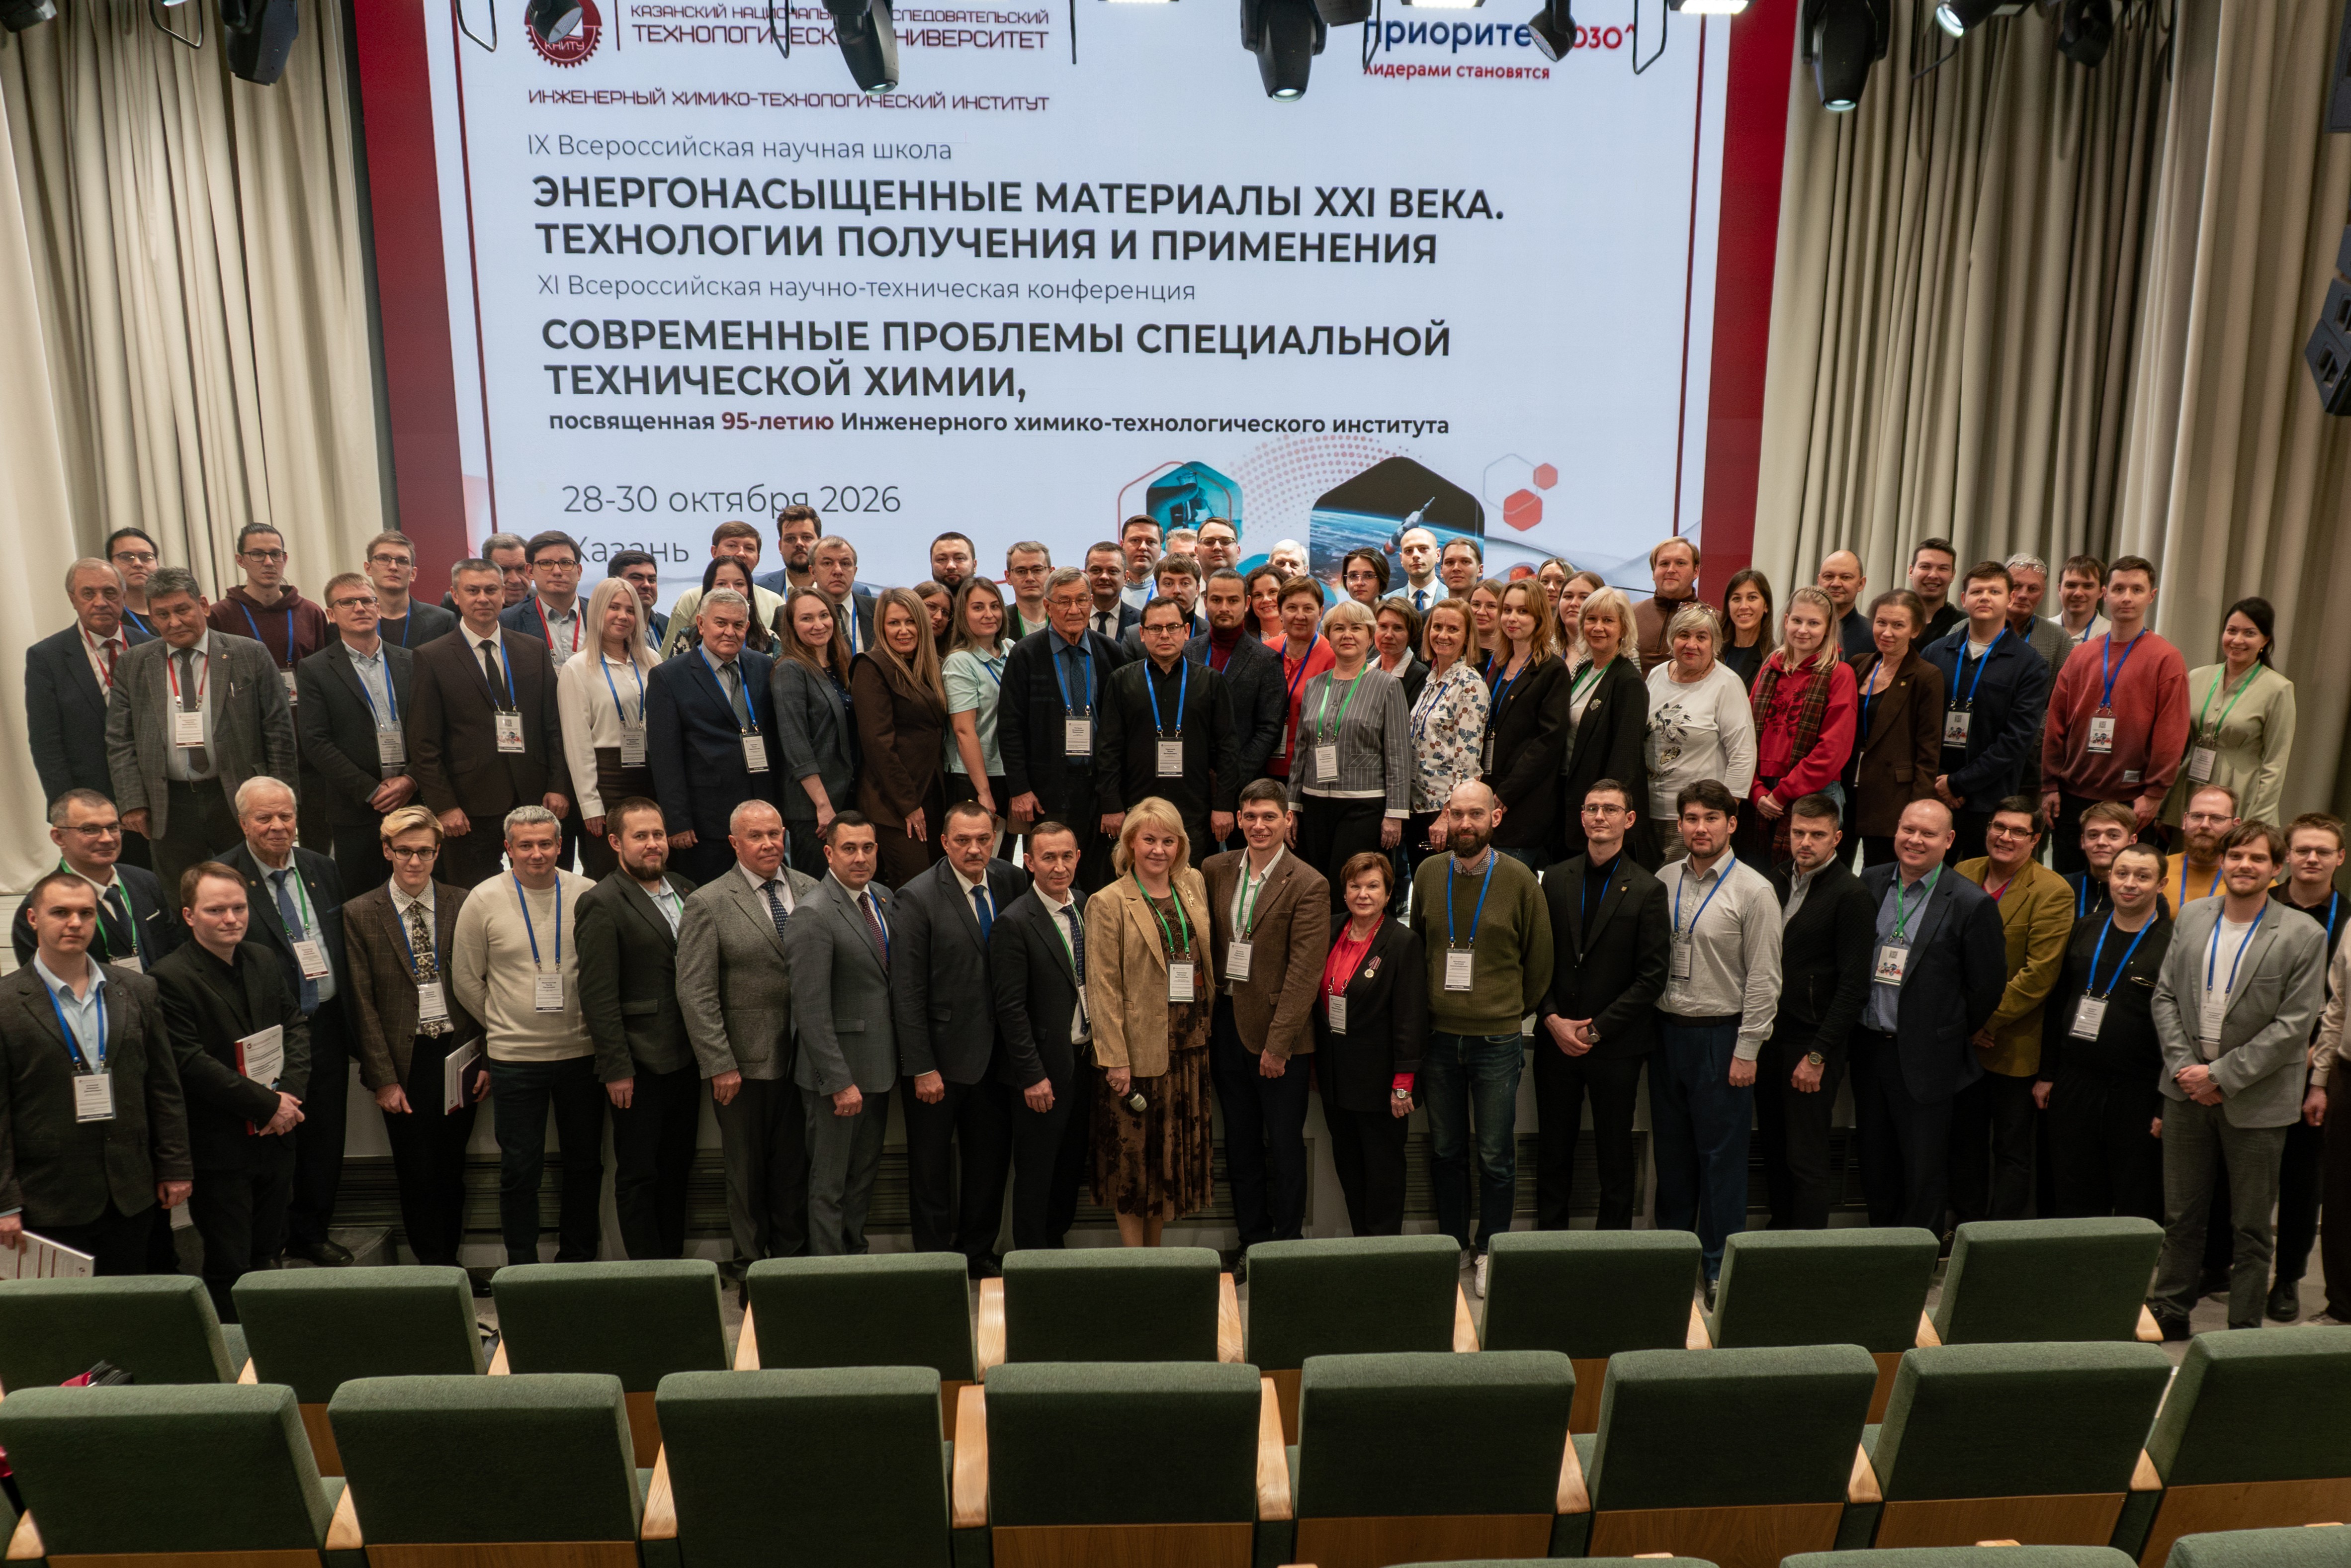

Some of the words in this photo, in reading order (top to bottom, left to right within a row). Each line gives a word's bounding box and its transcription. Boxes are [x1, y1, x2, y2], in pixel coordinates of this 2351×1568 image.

[631, 3, 727, 19] КАЗАНСКИЙ
[892, 9, 1049, 24] СЛЕДОВАТЕЛЬСКИЙ
[894, 28, 1049, 49] НИВЕРСИТЕТ
[1456, 65, 1550, 80] становятся
[528, 87, 666, 105] ИНЖЕНЕРНЫЙ
[672, 91, 946, 109] ХИМИКО-ТЕХНОЛОГИЧЕСКИЙ
[952, 95, 1050, 111] ИНСТИТУТ
[528, 134, 551, 155] IX
[558, 134, 754, 161] Всероссийская
[763, 142, 864, 163] научная
[873, 143, 952, 160] школа
[532, 174, 1023, 216] ЭНЕРГОНАСЫЩЕННЫЕ
[1036, 182, 1302, 216] МАТЕРИАЛЫ
[1313, 186, 1375, 218] XXI
[1390, 188, 1504, 220] ВЕКА.
[534, 223, 823, 257] ТЕХНОЛОГИИ
[838, 226, 1096, 260] ПОЛУЧЕНИЯ
[1111, 229, 1137, 260] И
[1152, 230, 1437, 264] ПРИМЕНЕНИЯ
[537, 274, 559, 294] XI
[568, 274, 761, 300] Всероссийская
[770, 280, 1019, 302] научно-техническая
[1028, 278, 1195, 304] конференция
[542, 318, 870, 351] СОВРЕМЕННЫЕ
[883, 321, 1123, 353] ПРОБЛЕМЫ
[1136, 319, 1451, 361] СПЕЦИАЛЬНОЙ
[543, 358, 851, 396] ТЕХНИЧЕСКОЙ
[863, 366, 1026, 402] ХИМИИ,
[549, 415, 715, 433] посвященная
[721, 412, 834, 431] 95-летию
[841, 413, 1008, 435] Инженерного
[1014, 417, 1326, 435] химико-технологического
[1332, 419, 1449, 437] института
[562, 485, 657, 513] 28-30
[669, 483, 809, 519] октября
[820, 485, 901, 513] 2026
